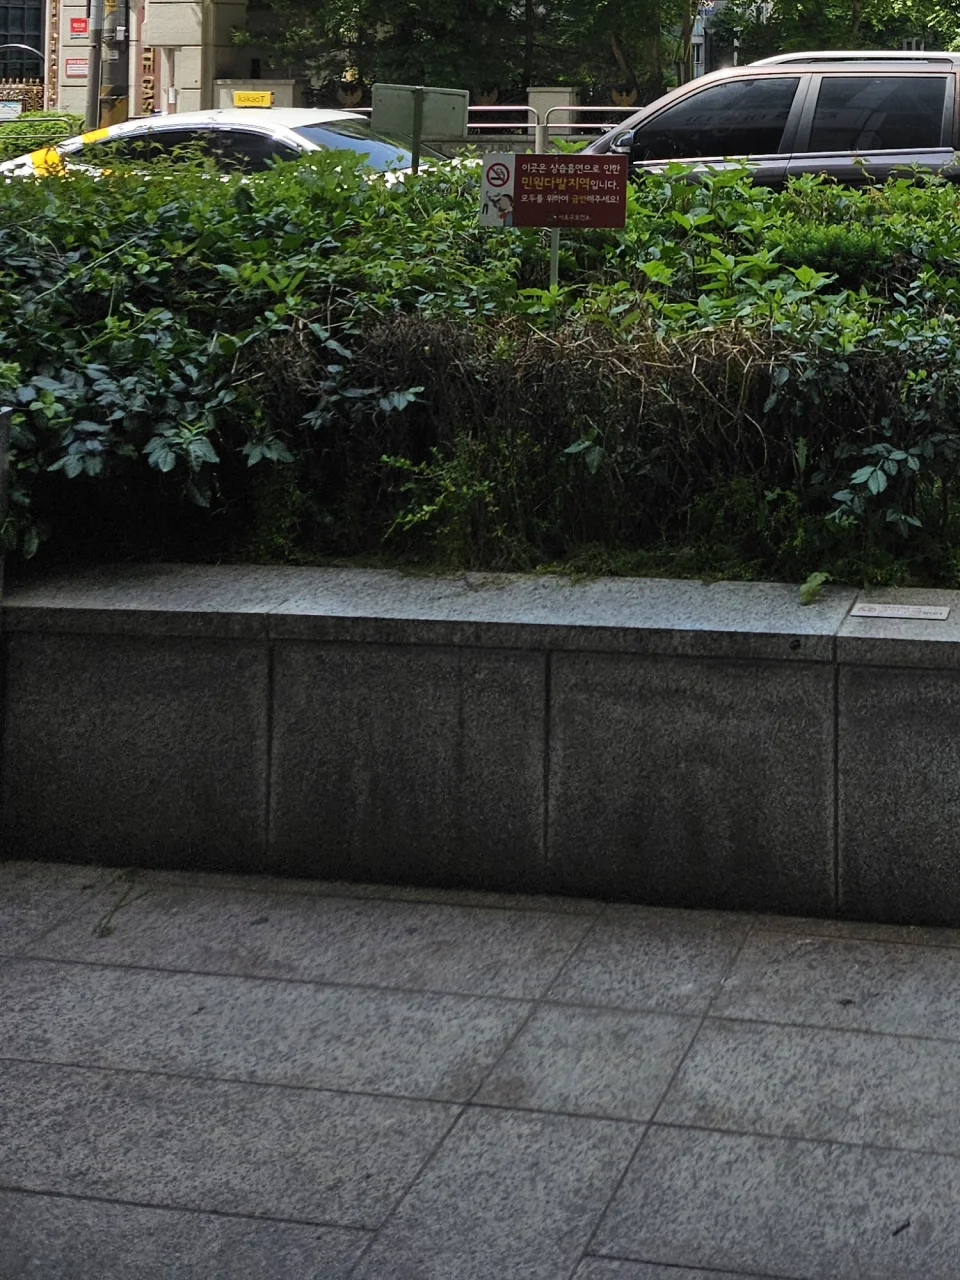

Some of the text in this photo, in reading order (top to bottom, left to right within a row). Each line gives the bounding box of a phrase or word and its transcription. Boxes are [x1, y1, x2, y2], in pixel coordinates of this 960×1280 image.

[521, 163, 621, 175] 이곳은 상습흡연으로 인한
[520, 194, 620, 204] 모두를 위하여 금연해주세요!
